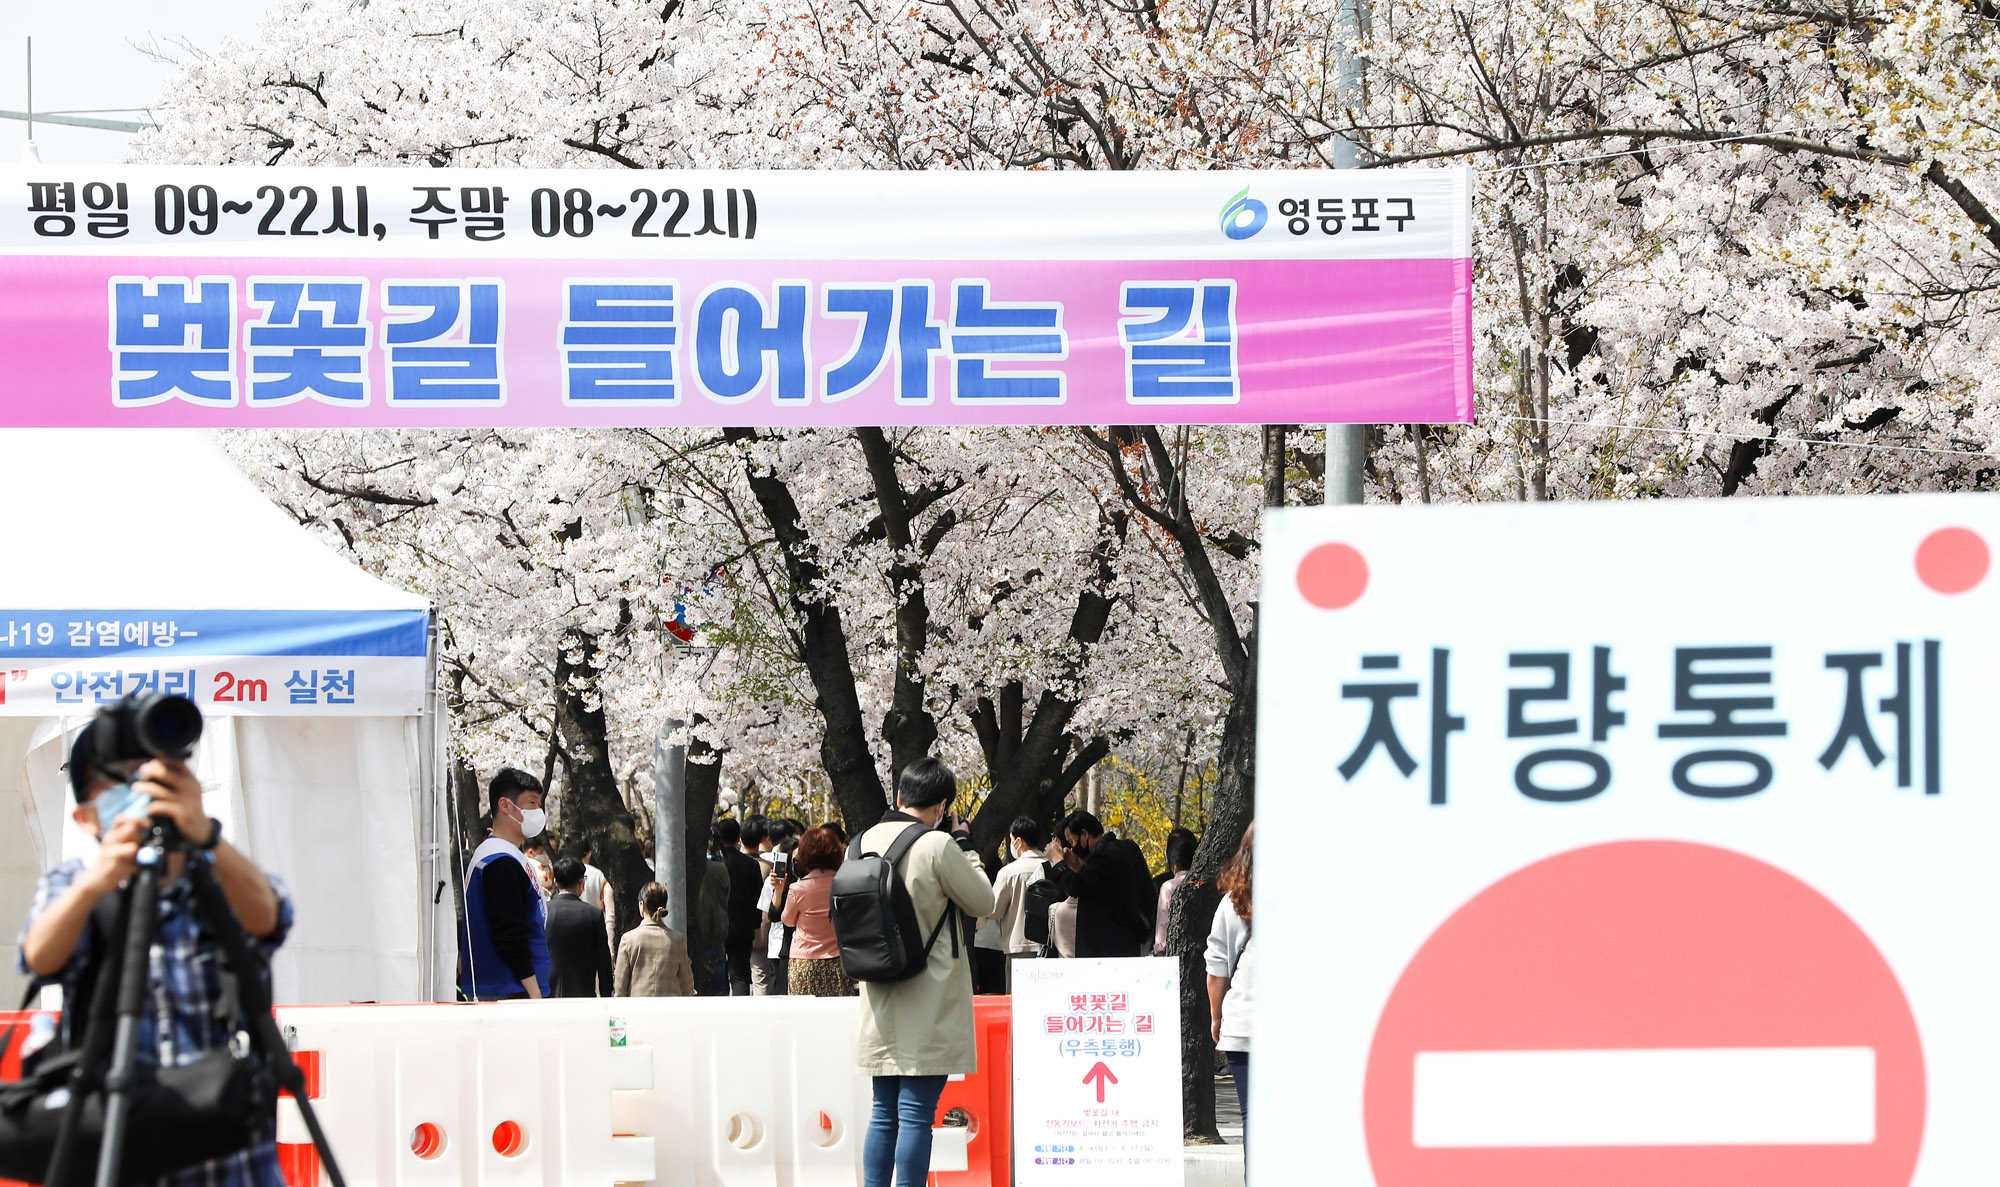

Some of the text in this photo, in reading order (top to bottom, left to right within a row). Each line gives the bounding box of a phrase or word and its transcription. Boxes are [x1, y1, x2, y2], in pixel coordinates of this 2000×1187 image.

[26, 181, 758, 242] 평일 09~22시, 주말 08~22시)
[1277, 196, 1416, 236] 영등포구
[112, 280, 1236, 403] 벚꽃길 들어가는 길
[213, 671, 268, 702] 2m
[284, 669, 355, 704] 실천
[1335, 637, 1942, 806] 차량통제
[1069, 993, 1128, 1012] 벚꽃길
[1045, 1014, 1153, 1034] 들어가는 길
[1058, 1038, 1142, 1057] (우측통행)
